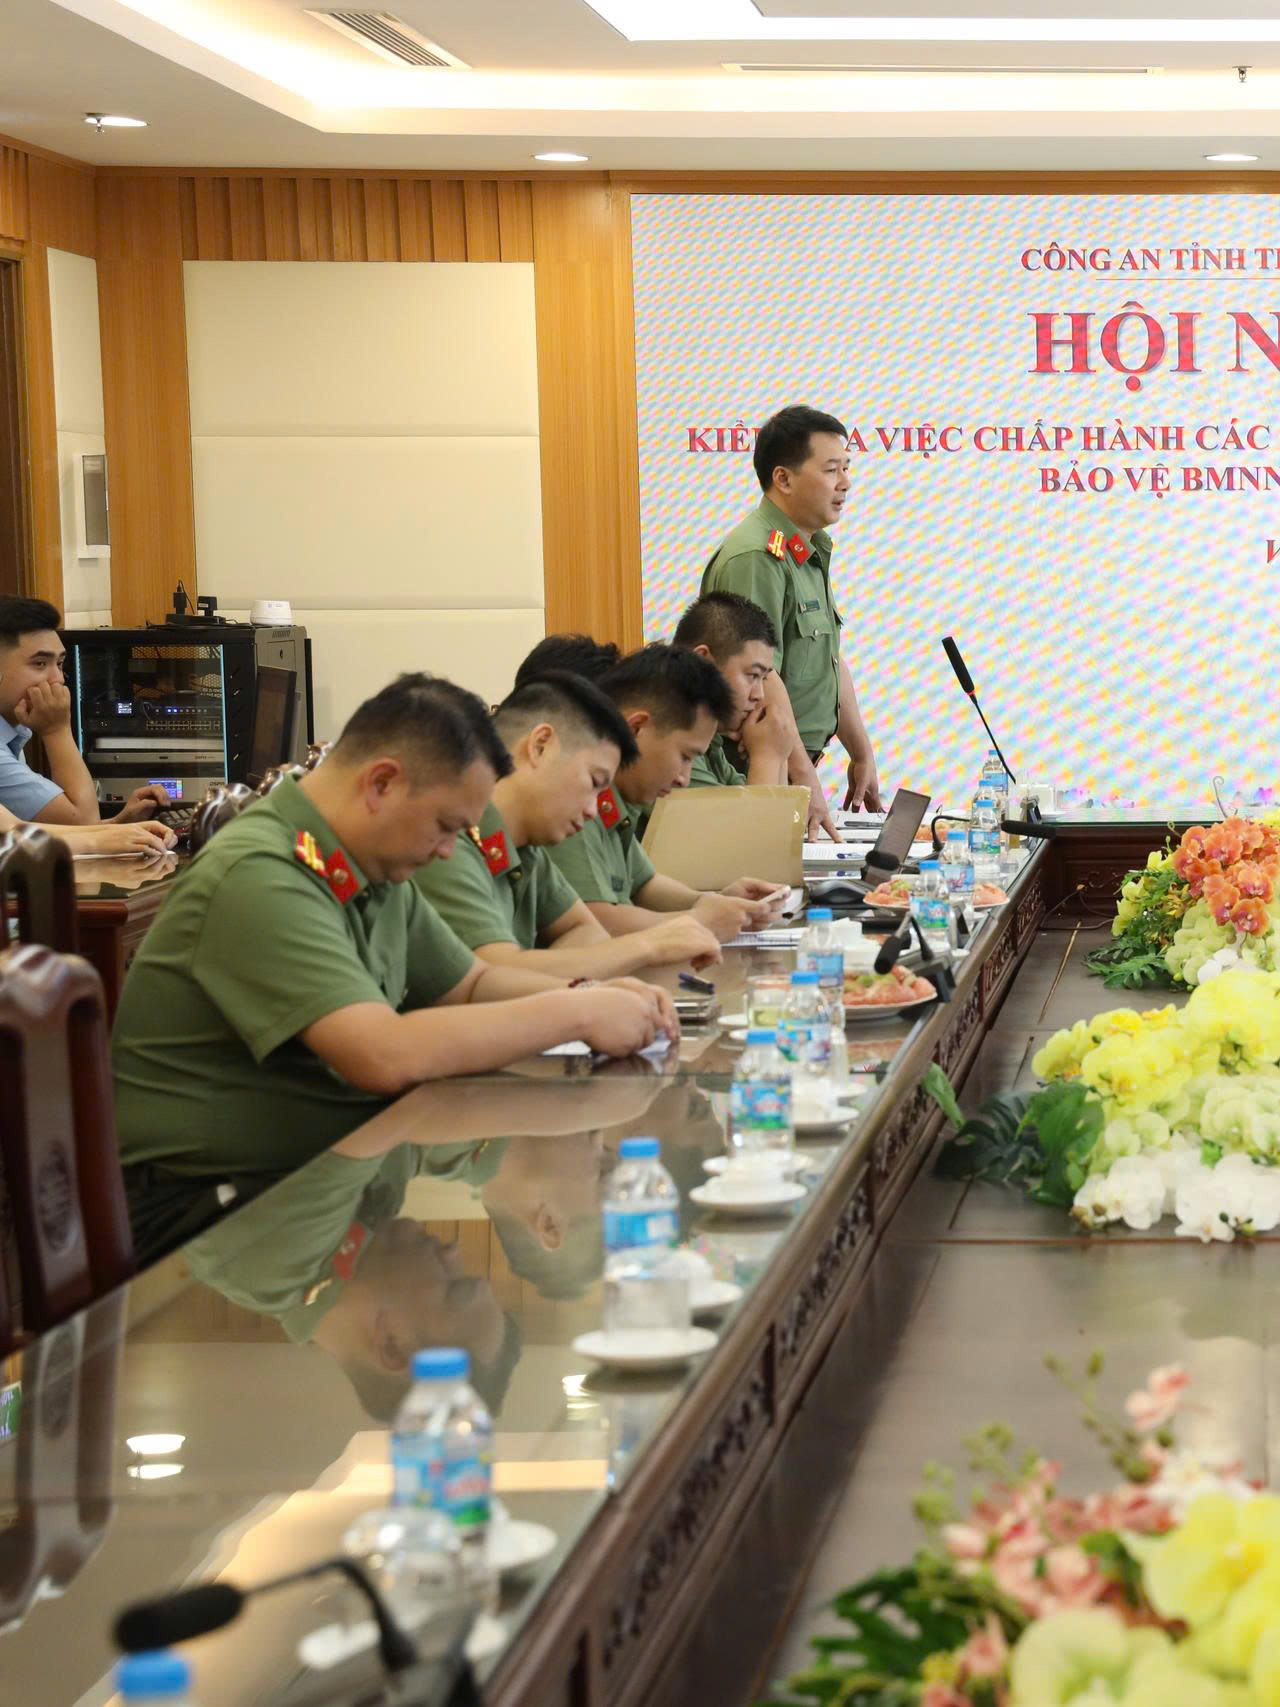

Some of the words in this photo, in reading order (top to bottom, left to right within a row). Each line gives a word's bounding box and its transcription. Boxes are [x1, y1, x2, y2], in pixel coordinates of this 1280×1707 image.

[1021, 241, 1111, 271] CÔNG
[1119, 248, 1161, 271] AN
[1169, 242, 1246, 271] TỈNH
[1027, 301, 1202, 392] HỘI
[876, 423, 963, 459] VIỆC
[973, 418, 1074, 452] CHẤP
[1081, 418, 1185, 451] HÀNH
[1195, 418, 1271, 451] CÁC
[1038, 460, 1115, 493] BẢO
[1122, 463, 1170, 499] VỆ
